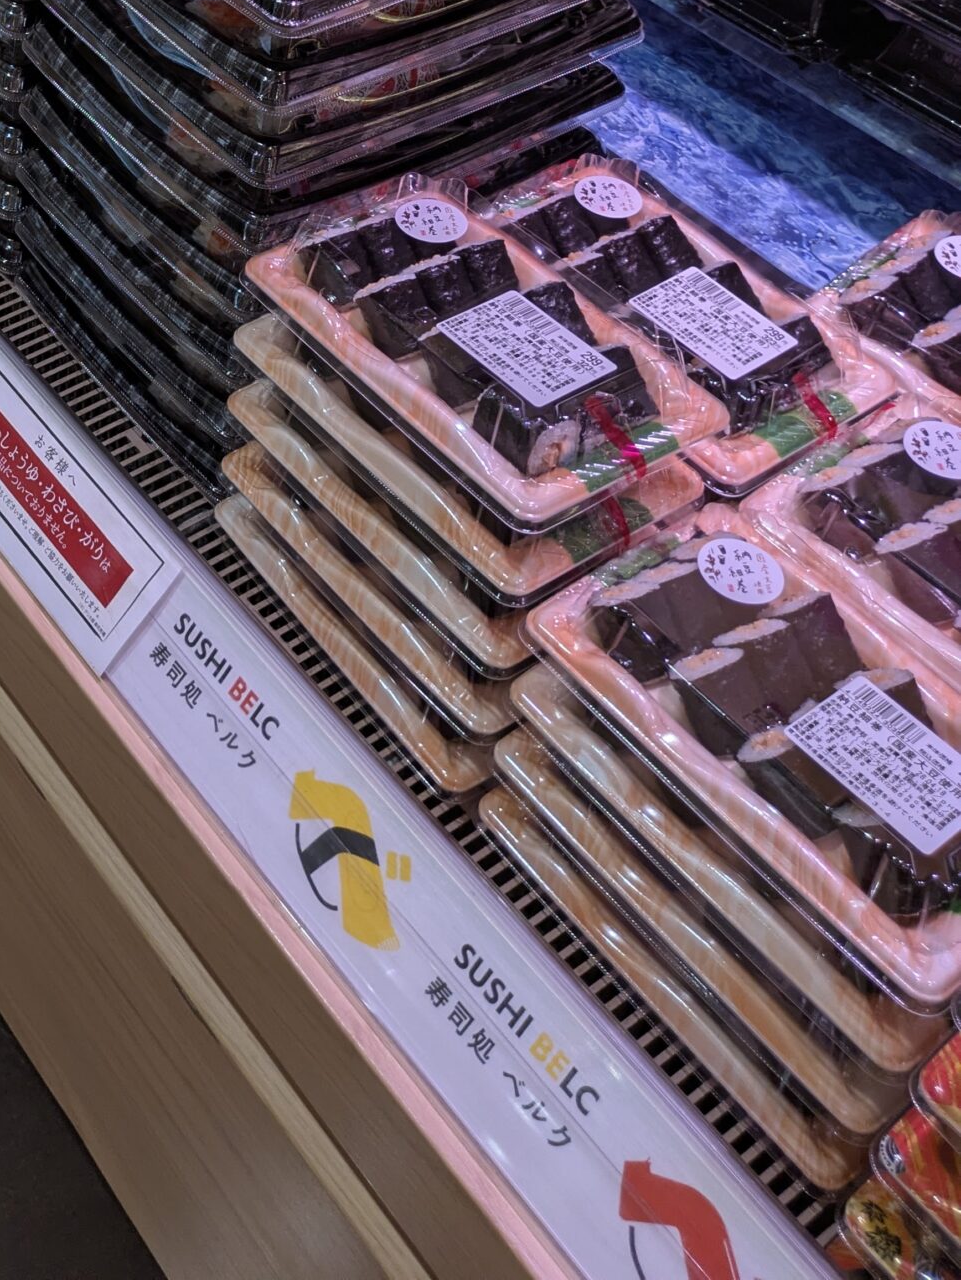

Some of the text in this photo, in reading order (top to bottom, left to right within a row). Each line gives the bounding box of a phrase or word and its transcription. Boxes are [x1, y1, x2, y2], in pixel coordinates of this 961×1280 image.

[34, 434, 76, 486] お客様へ
[148, 641, 258, 770] 寿司処 ベルク
[172, 612, 281, 741] SUSHI BELC
[423, 977, 574, 1150] 寿司処 ベルク
[453, 943, 601, 1116] SUSHI BELC
